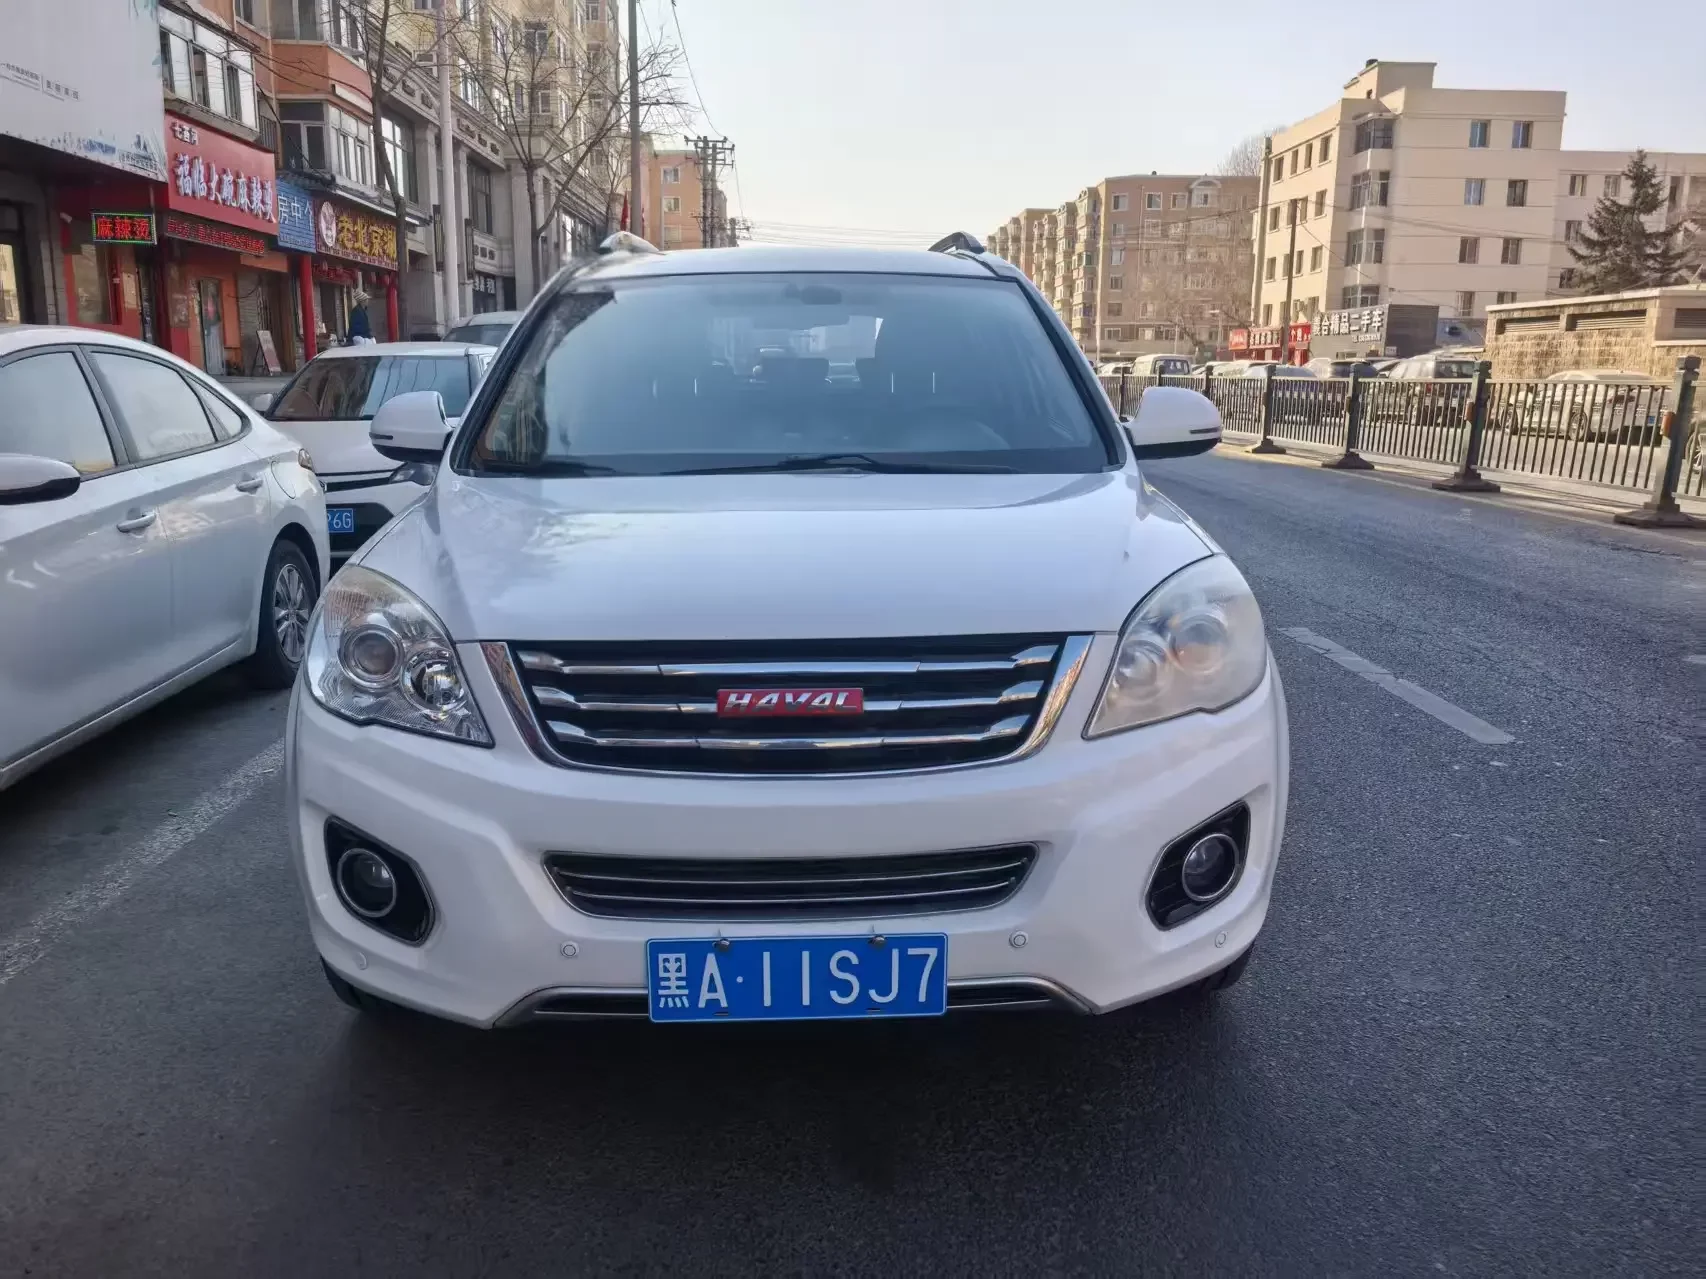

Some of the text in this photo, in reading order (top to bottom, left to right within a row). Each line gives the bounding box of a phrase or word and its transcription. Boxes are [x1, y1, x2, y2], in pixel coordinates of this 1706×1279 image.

[96, 215, 151, 240] 麻辣烫
[724, 691, 858, 713] HAVAL
